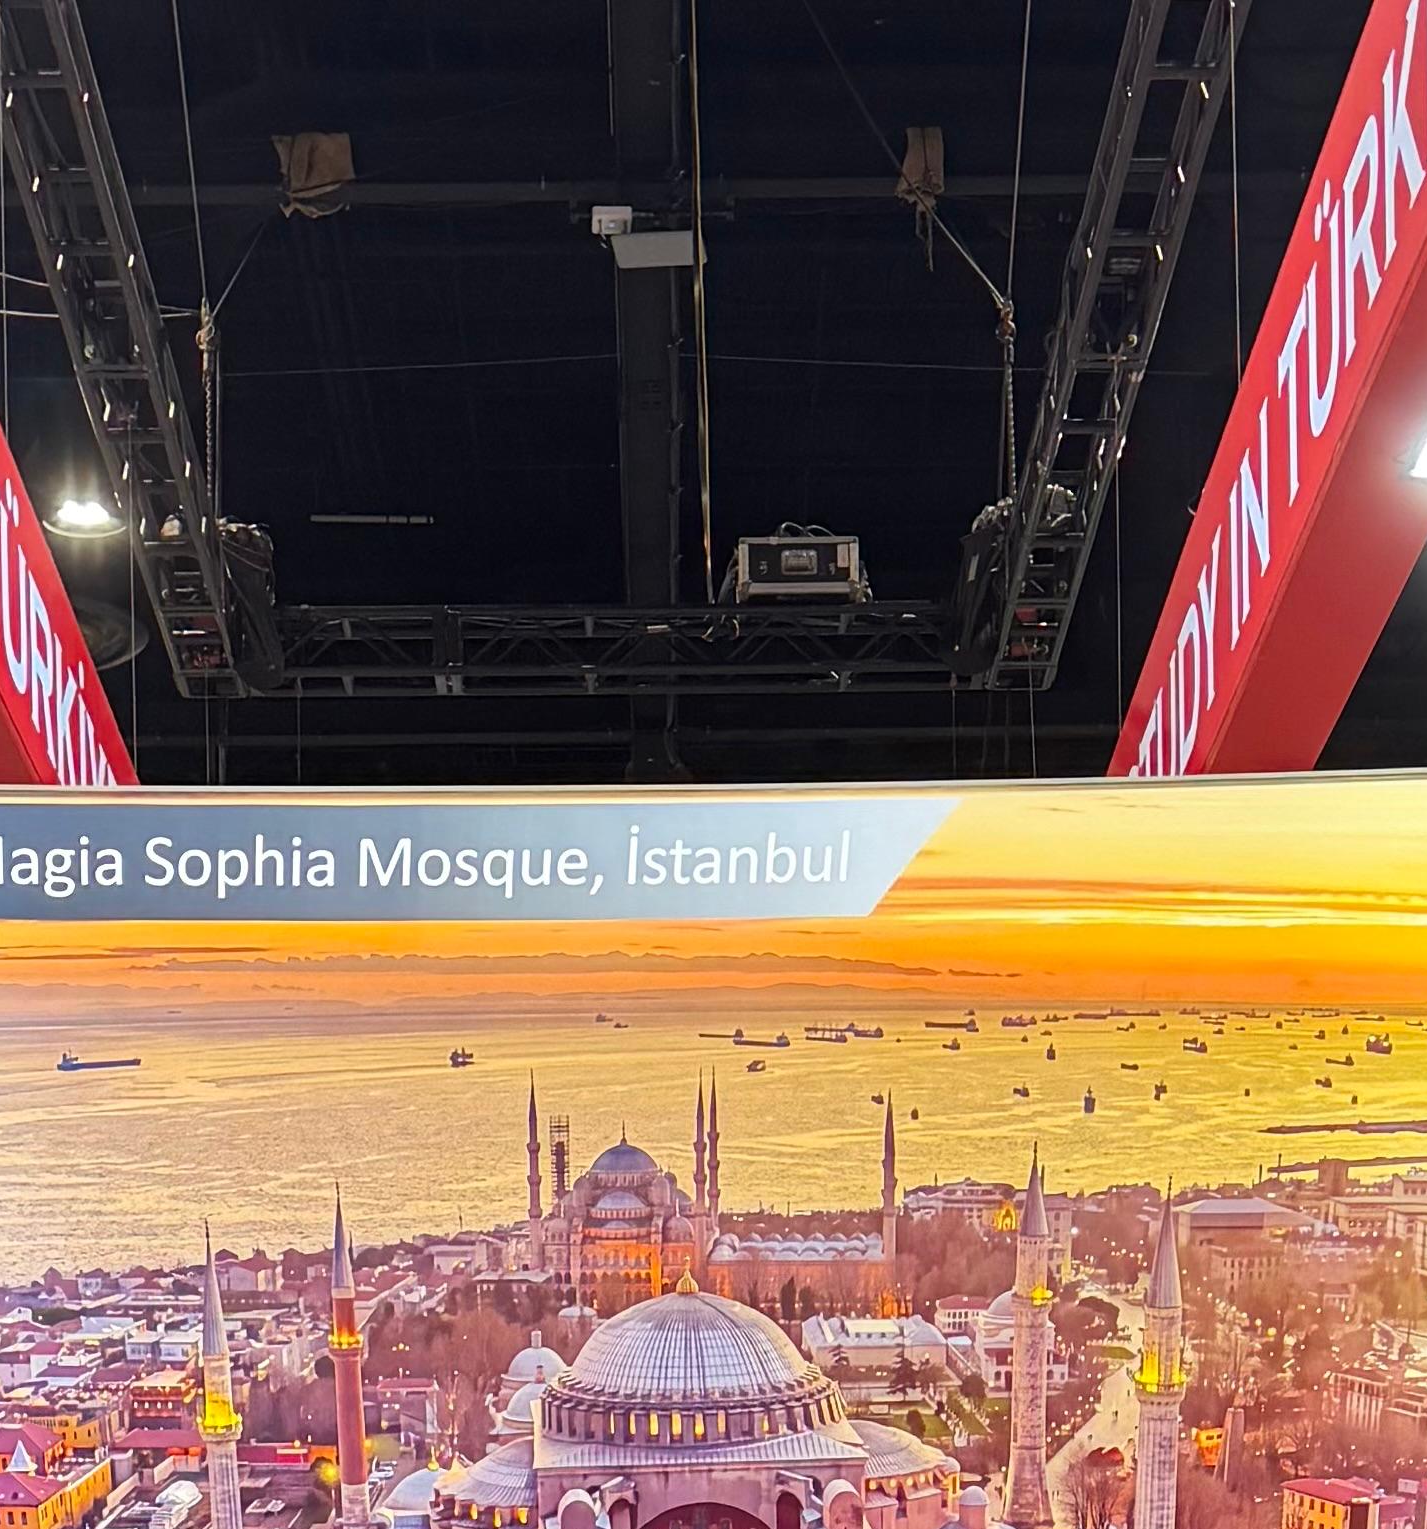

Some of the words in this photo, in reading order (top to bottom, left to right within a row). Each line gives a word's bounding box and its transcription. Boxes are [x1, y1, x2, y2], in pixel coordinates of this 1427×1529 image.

[1229, 396, 1272, 652] IN
[144, 834, 336, 898] Sophia
[358, 836, 604, 896] Mosque,
[625, 825, 851, 885] İstanbul
